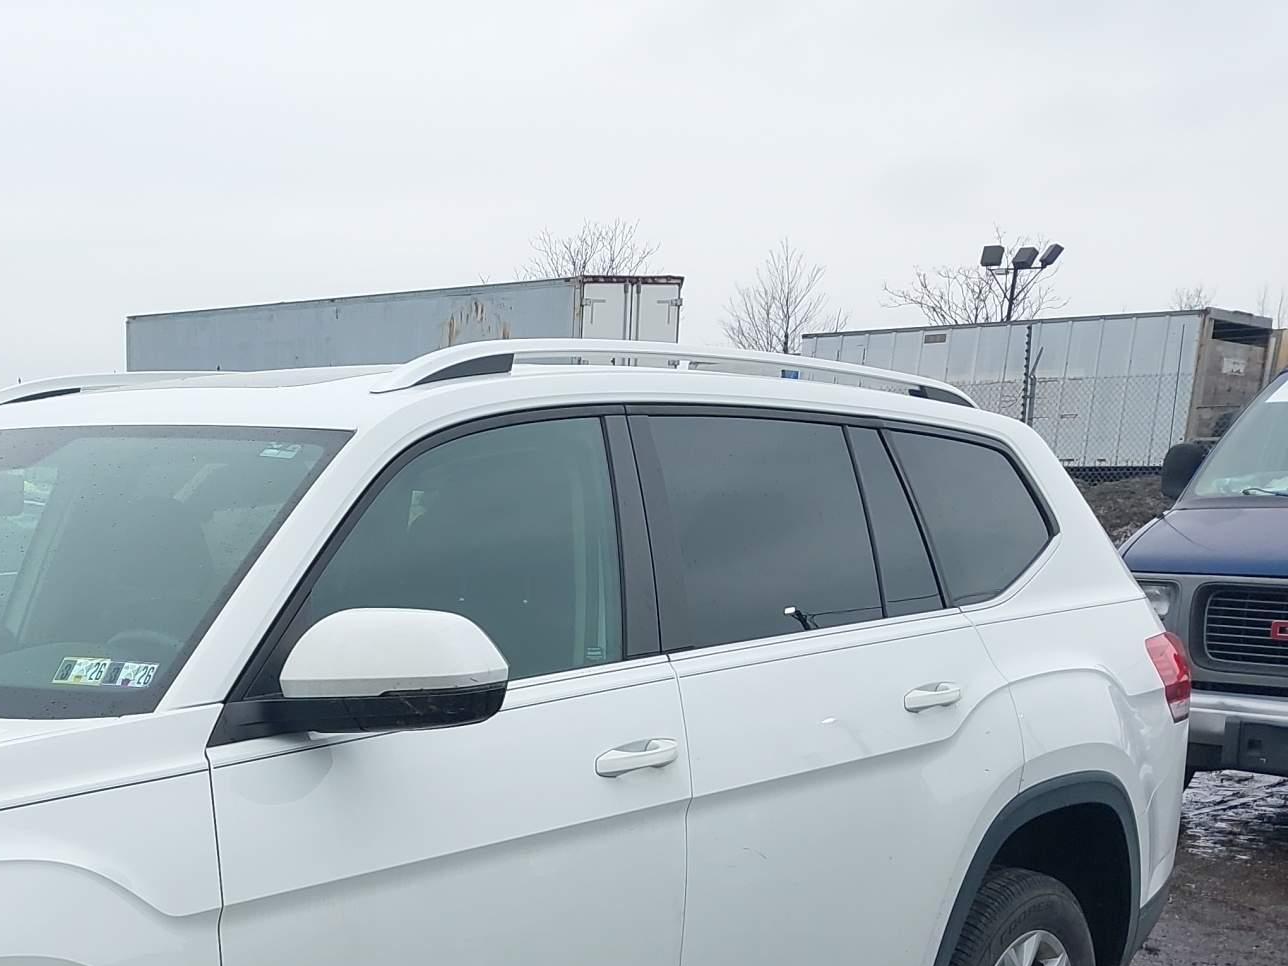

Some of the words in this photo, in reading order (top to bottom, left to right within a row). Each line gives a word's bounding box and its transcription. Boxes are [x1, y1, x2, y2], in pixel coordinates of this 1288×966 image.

[61, 664, 72, 680] 3
[89, 662, 107, 681] 26
[137, 666, 155, 685] 26
